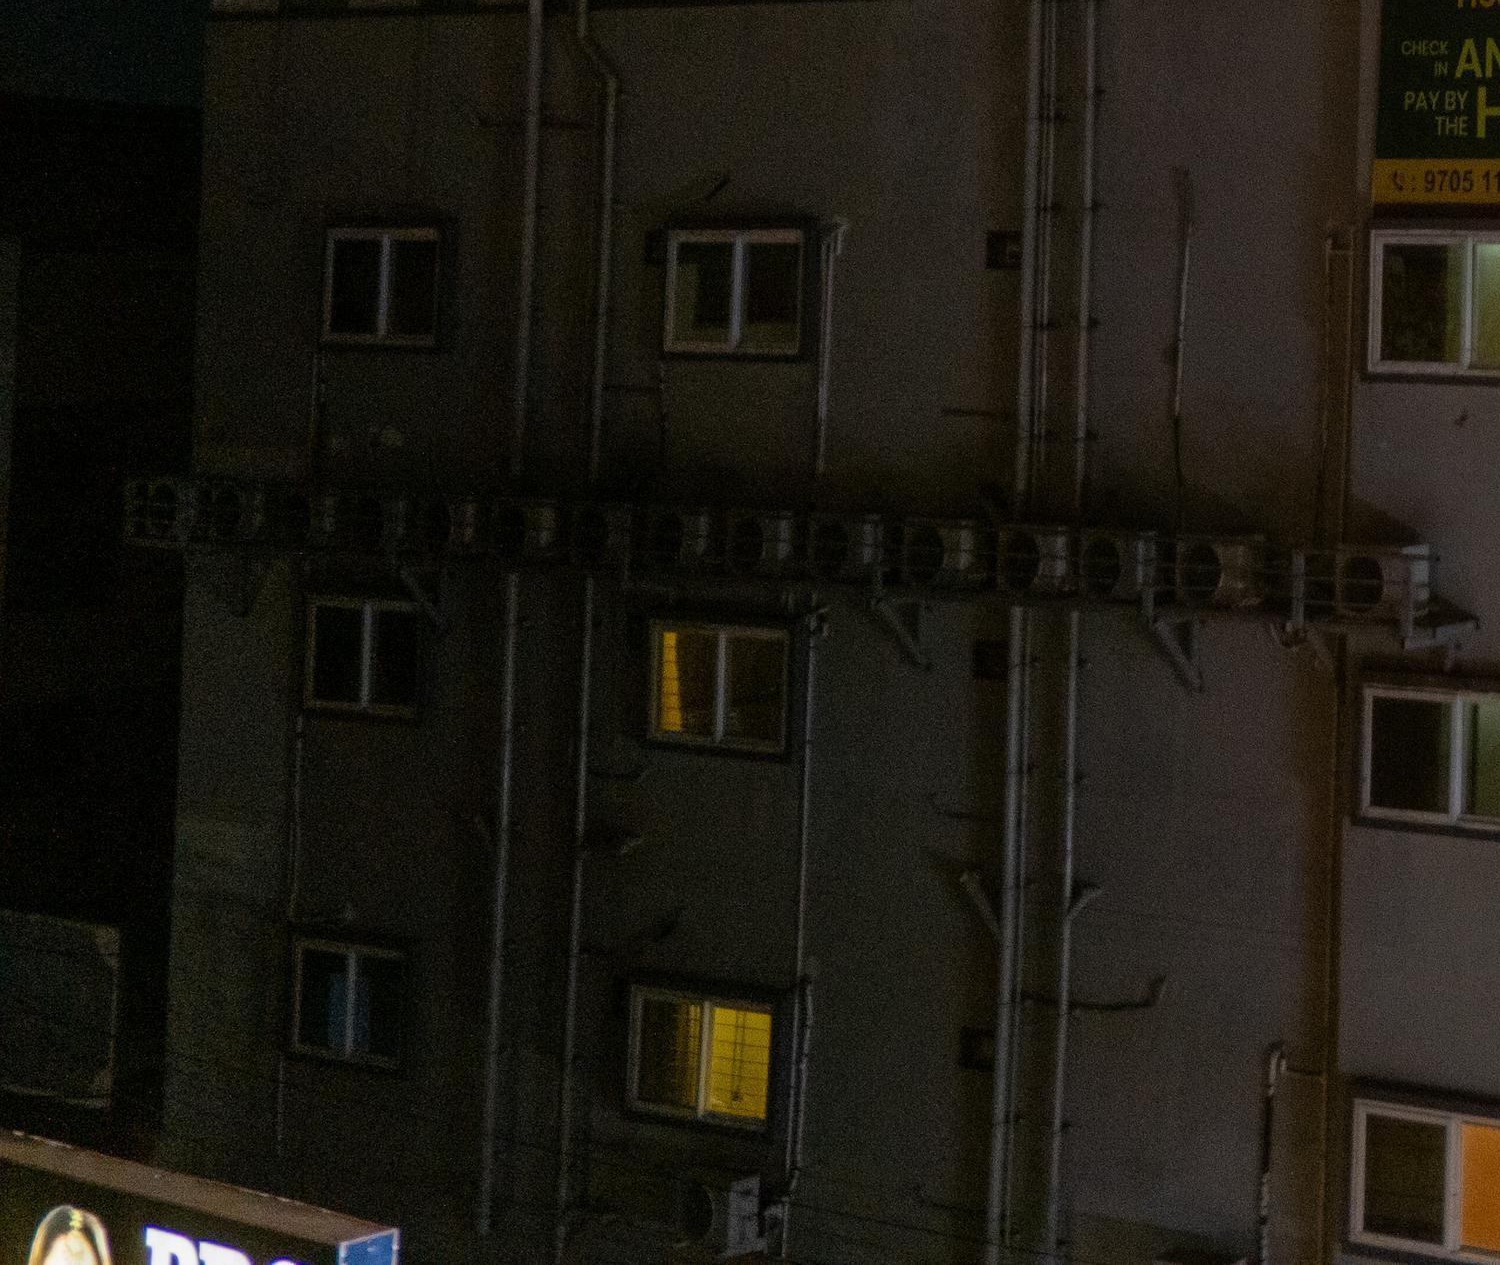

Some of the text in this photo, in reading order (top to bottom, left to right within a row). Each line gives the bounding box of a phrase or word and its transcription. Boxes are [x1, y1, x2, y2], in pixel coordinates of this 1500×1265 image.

[1401, 40, 1449, 56] CHECK
[1433, 62, 1449, 77] IN
[1404, 90, 1469, 111] PAY BY
[1435, 115, 1469, 136] THE
[1423, 168, 1474, 193] 9705
